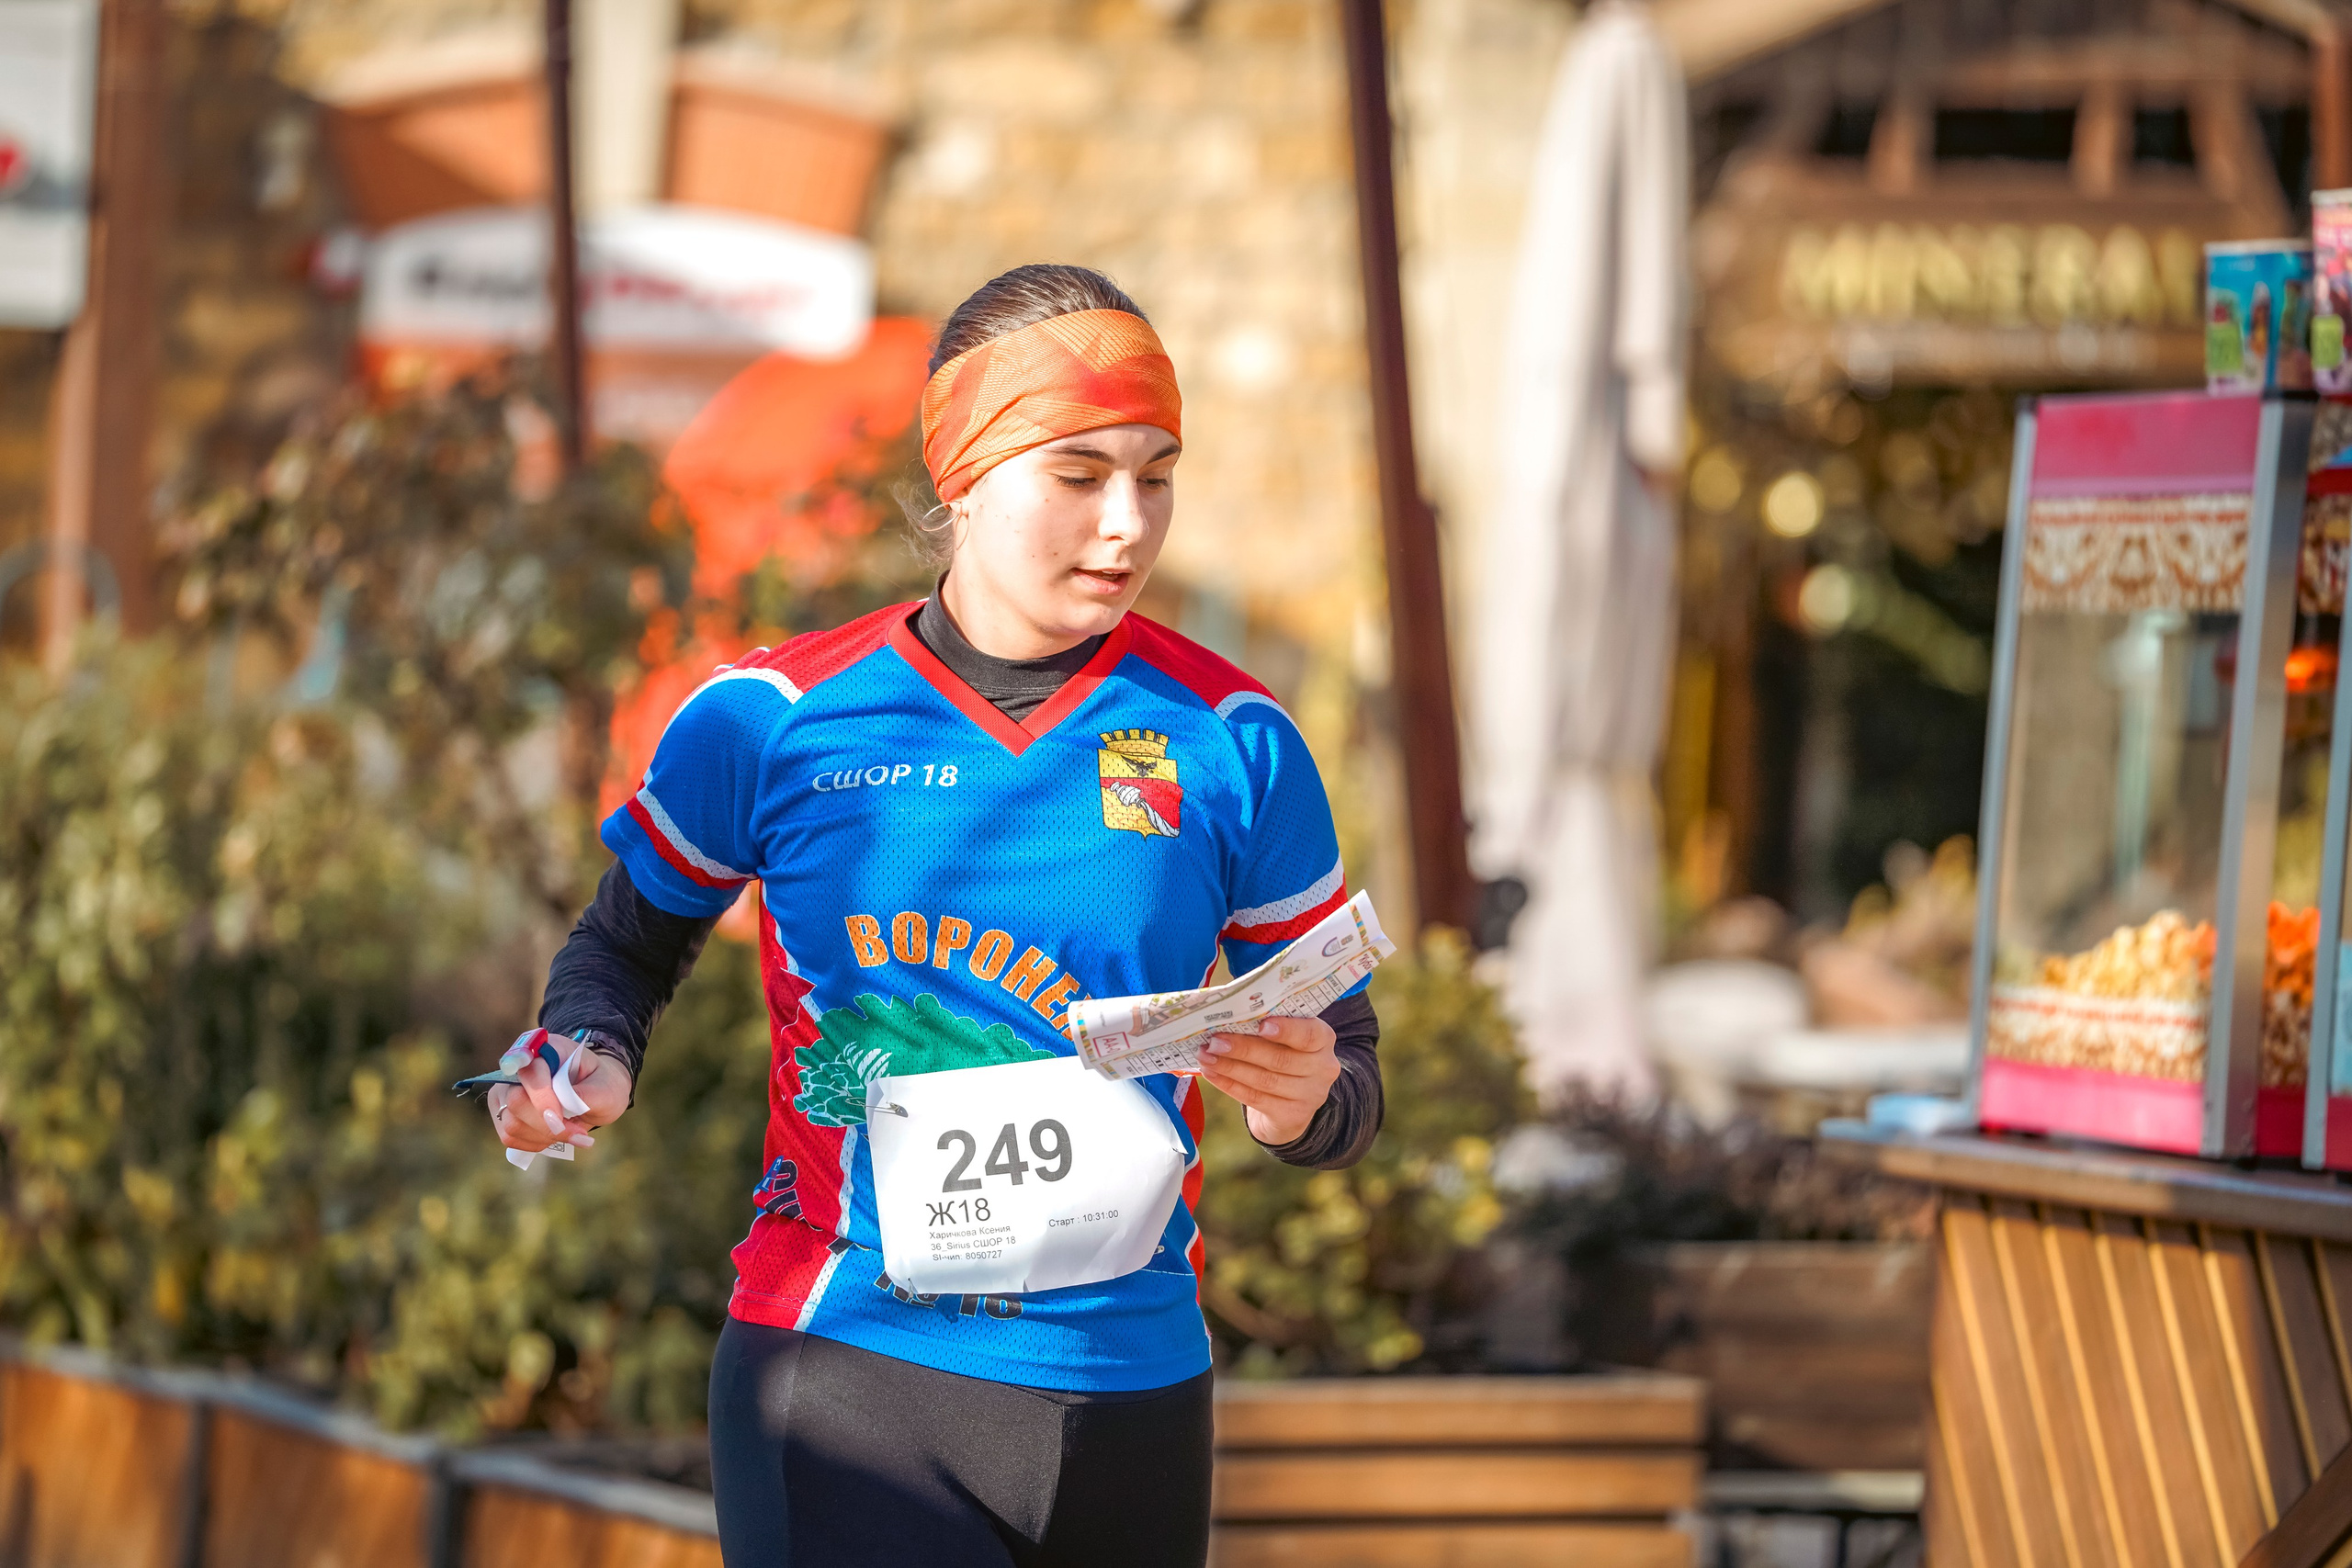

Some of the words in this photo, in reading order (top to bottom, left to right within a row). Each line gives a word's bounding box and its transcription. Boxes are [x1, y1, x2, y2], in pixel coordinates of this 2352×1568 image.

[812, 764, 912, 793] СШОР
[923, 764, 958, 787] 18
[844, 911, 1092, 1042] ВОРОНЕ
[937, 1118, 1072, 1193] 249
[926, 1198, 991, 1226] Ж18
[1048, 1217, 1075, 1227] Старт
[1082, 1209, 1119, 1223] 10:31:00
[929, 1229, 978, 1240] Харичкова
[979, 1225, 1012, 1235] Ксения
[973, 1236, 1003, 1248] СШОР
[1006, 1235, 1016, 1245] 18
[965, 1249, 1002, 1260] 8050727
